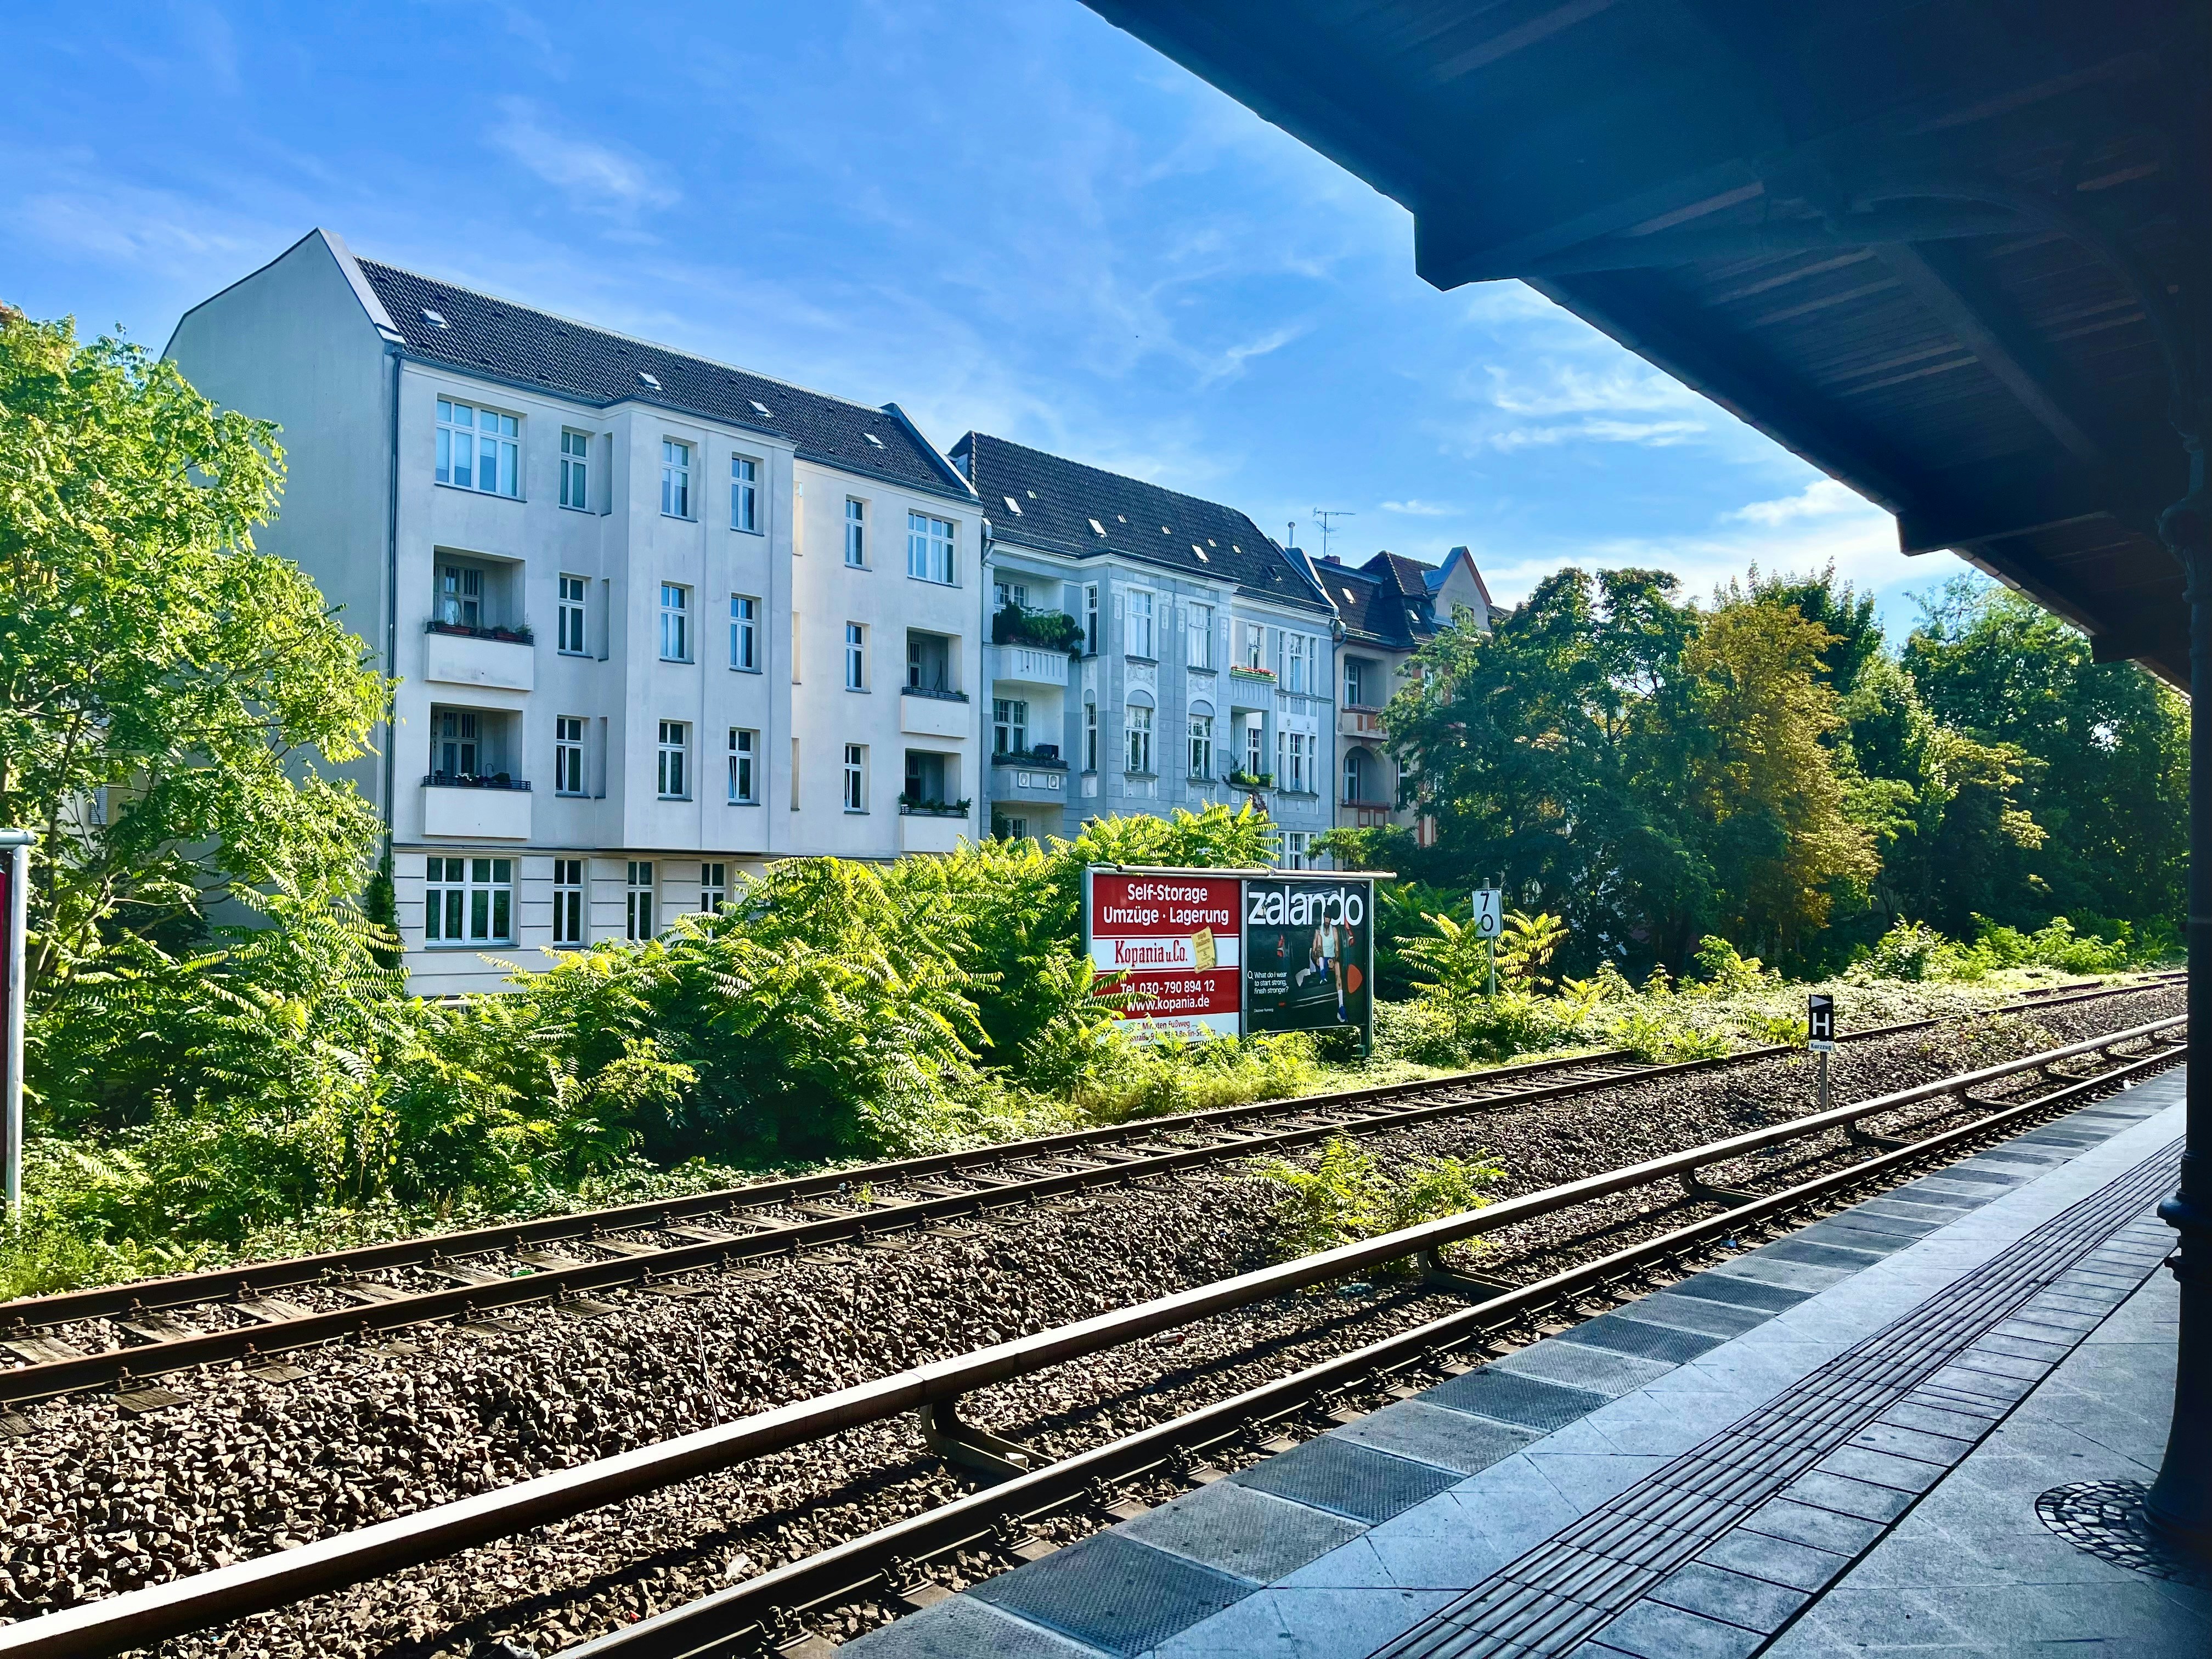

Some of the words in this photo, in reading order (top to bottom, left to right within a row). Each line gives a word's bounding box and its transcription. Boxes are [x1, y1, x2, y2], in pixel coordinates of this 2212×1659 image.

[1127, 883, 1208, 904] Self-Storage
[1480, 893, 1489, 912] 7
[1248, 885, 1363, 926] zalando
[1103, 906, 1159, 926] Umzüge
[1170, 907, 1229, 926] Lagerung
[1115, 940, 1165, 968] Kopania
[1184, 980, 1201, 993] 894
[1204, 979, 1215, 992] 12
[1127, 994, 1210, 1013] www.kopania.de
[1812, 1012, 1830, 1036] H
[1810, 1043, 1832, 1051] Kurzzug
